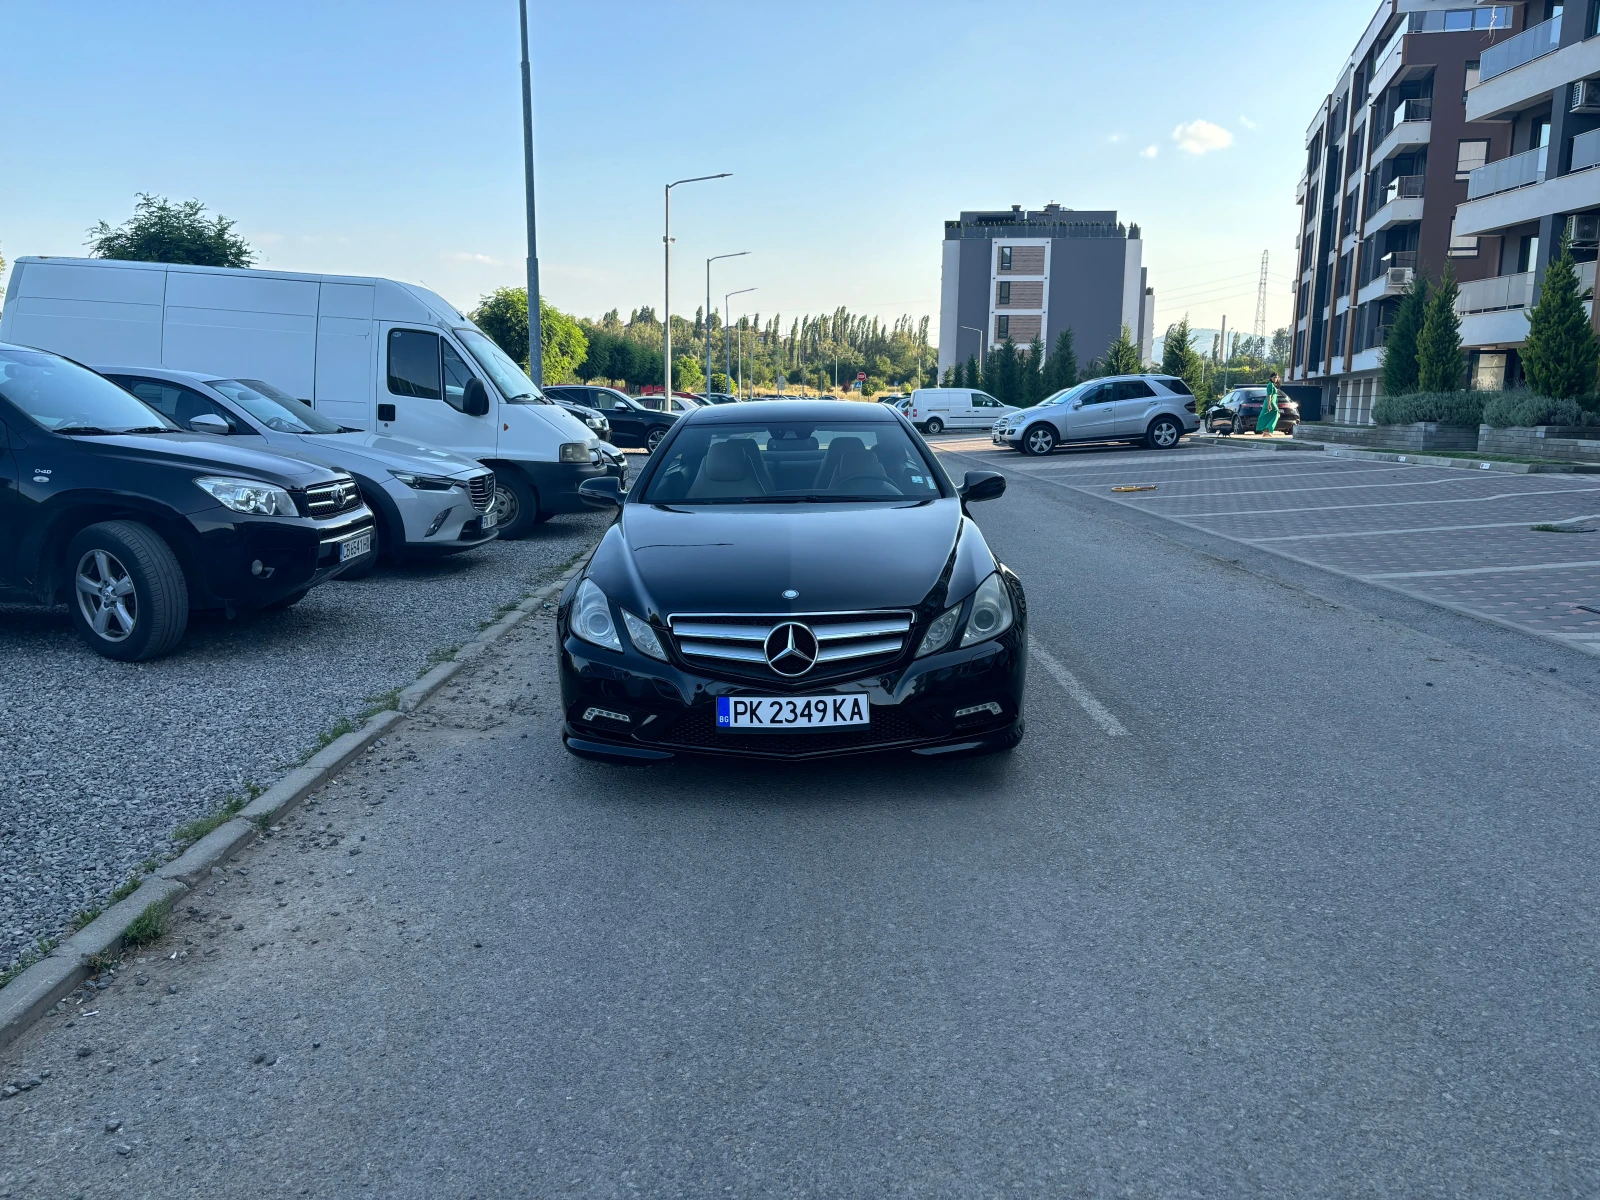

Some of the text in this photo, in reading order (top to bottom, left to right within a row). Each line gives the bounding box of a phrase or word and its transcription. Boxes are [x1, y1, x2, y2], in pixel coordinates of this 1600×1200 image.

[719, 715, 729, 723] BG
[733, 698, 863, 724] PK 2349 KA
